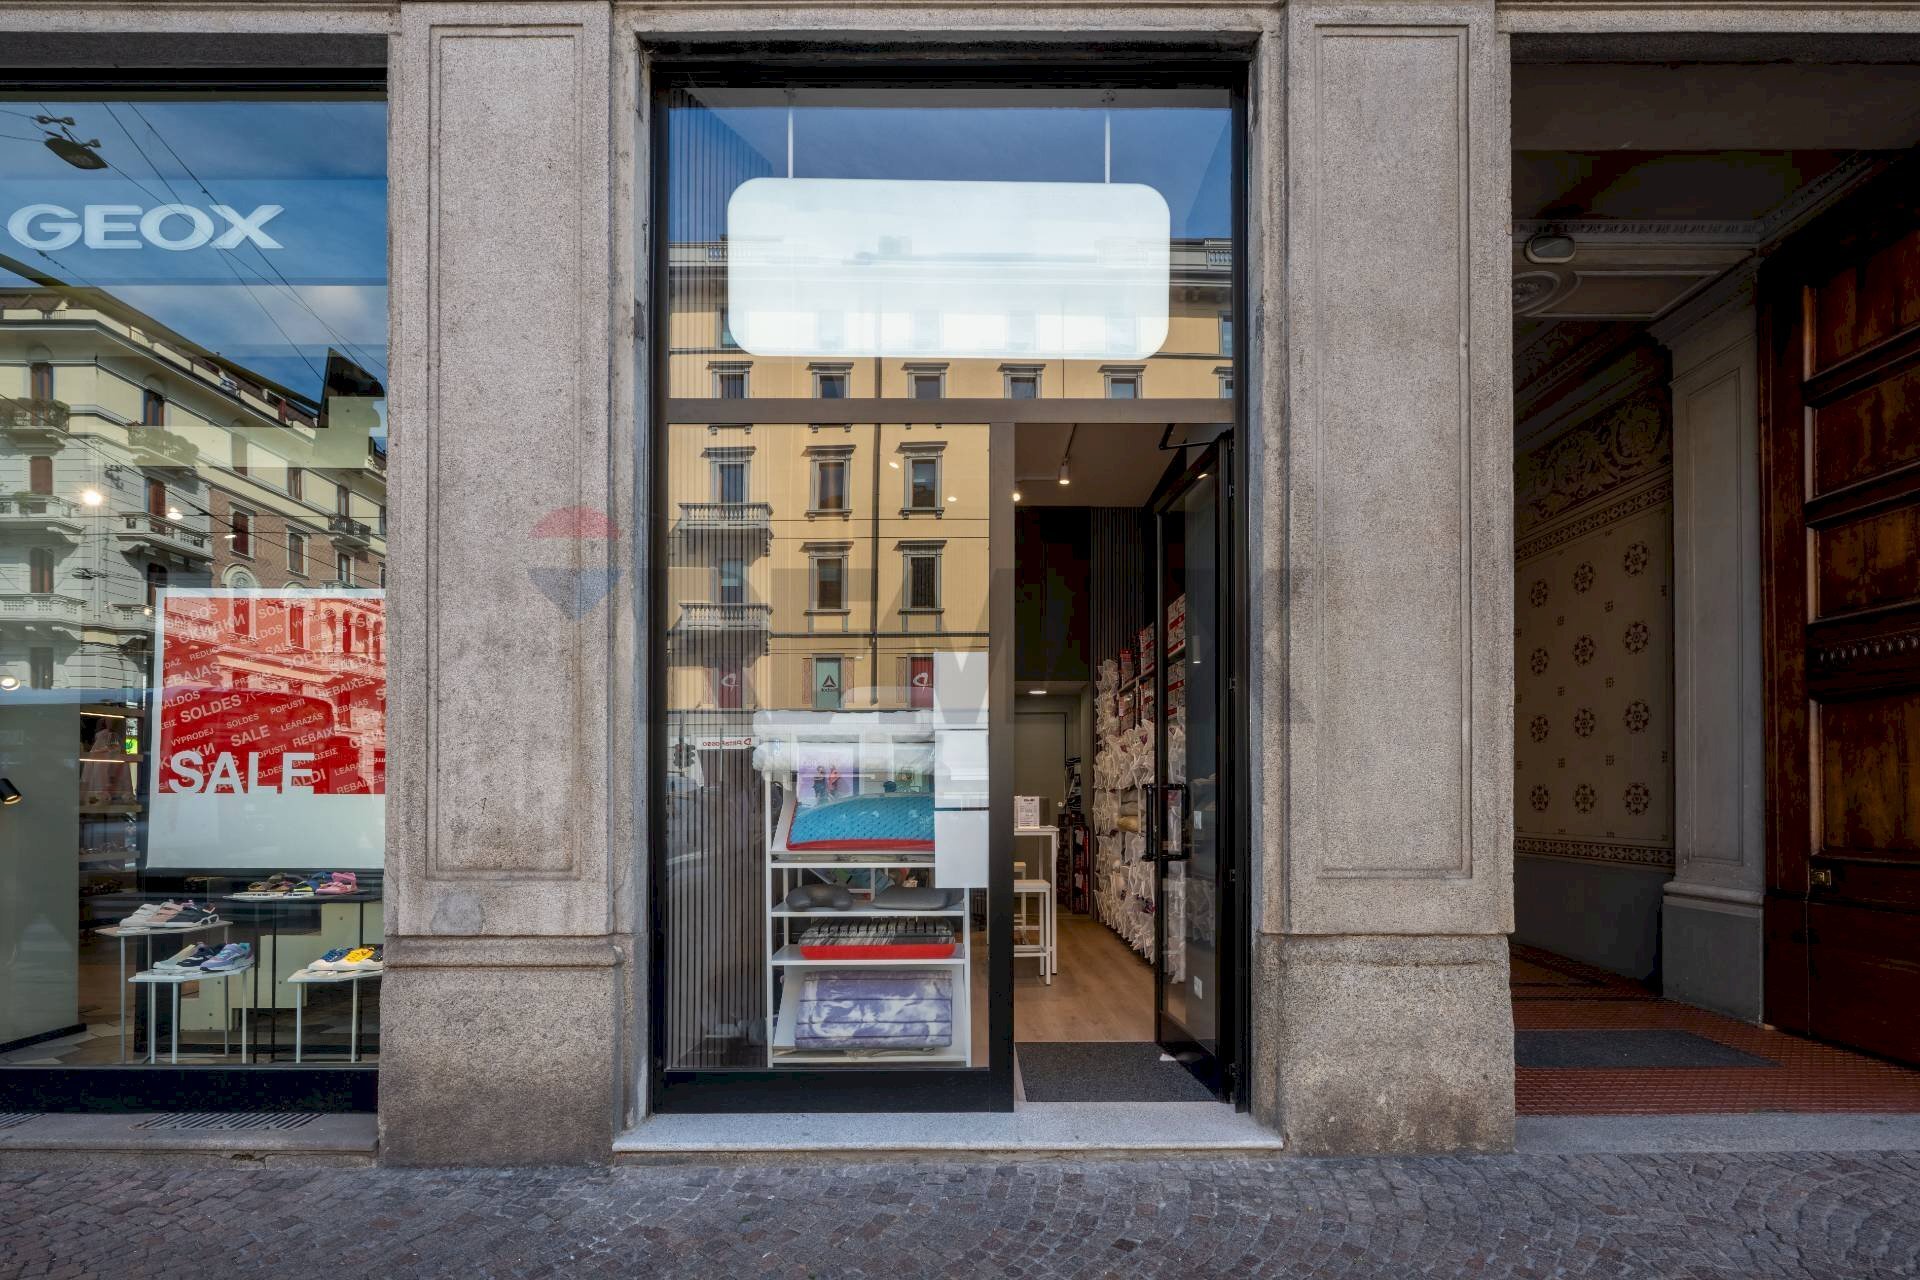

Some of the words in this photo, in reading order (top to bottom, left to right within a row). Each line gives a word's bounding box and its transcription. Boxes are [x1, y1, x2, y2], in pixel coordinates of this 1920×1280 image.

[7, 203, 285, 251] GEOX
[160, 690, 201, 711] ALDOS
[180, 693, 242, 723] SOLDES
[270, 699, 306, 715] POPUSTI
[226, 713, 260, 729] SOLDES
[171, 727, 215, 747] VÝPRODEJ
[231, 724, 271, 747] SALE
[168, 750, 315, 794] SALE
